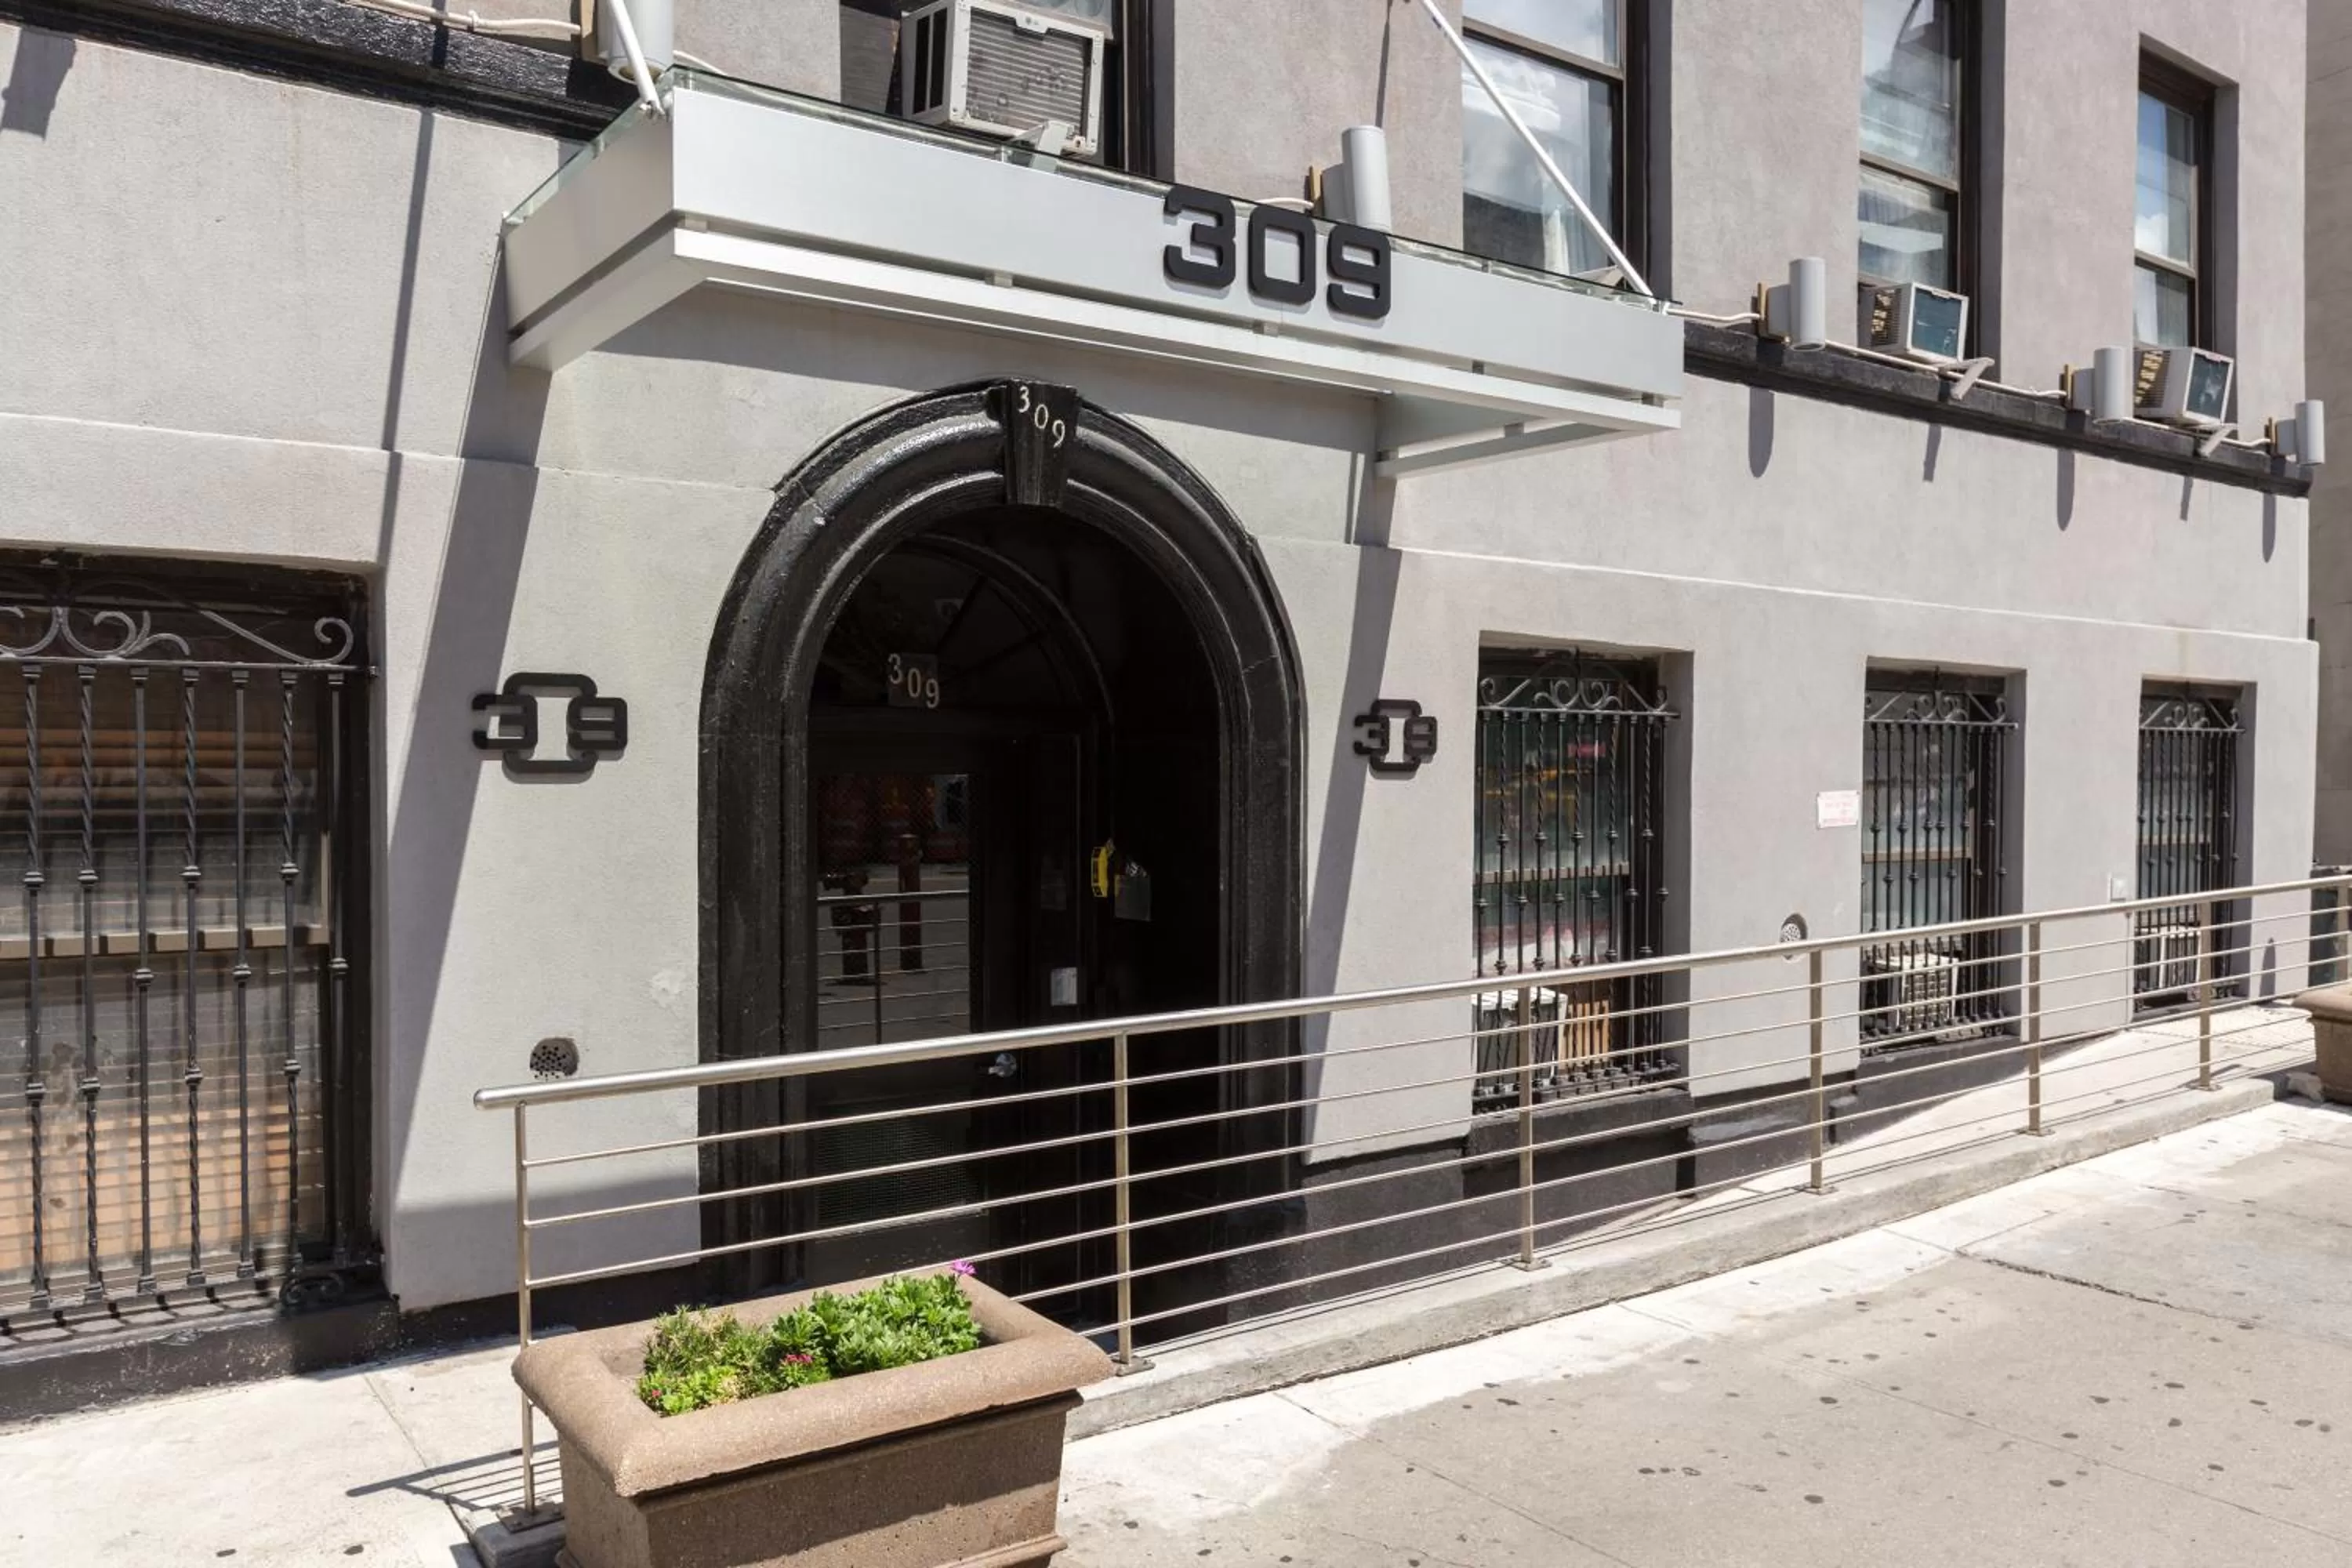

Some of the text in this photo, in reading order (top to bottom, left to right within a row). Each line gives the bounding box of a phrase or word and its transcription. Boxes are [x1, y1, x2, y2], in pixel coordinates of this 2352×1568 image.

[1163, 183, 1391, 318] 309
[1018, 385, 1065, 448] 309
[887, 653, 939, 709] 309
